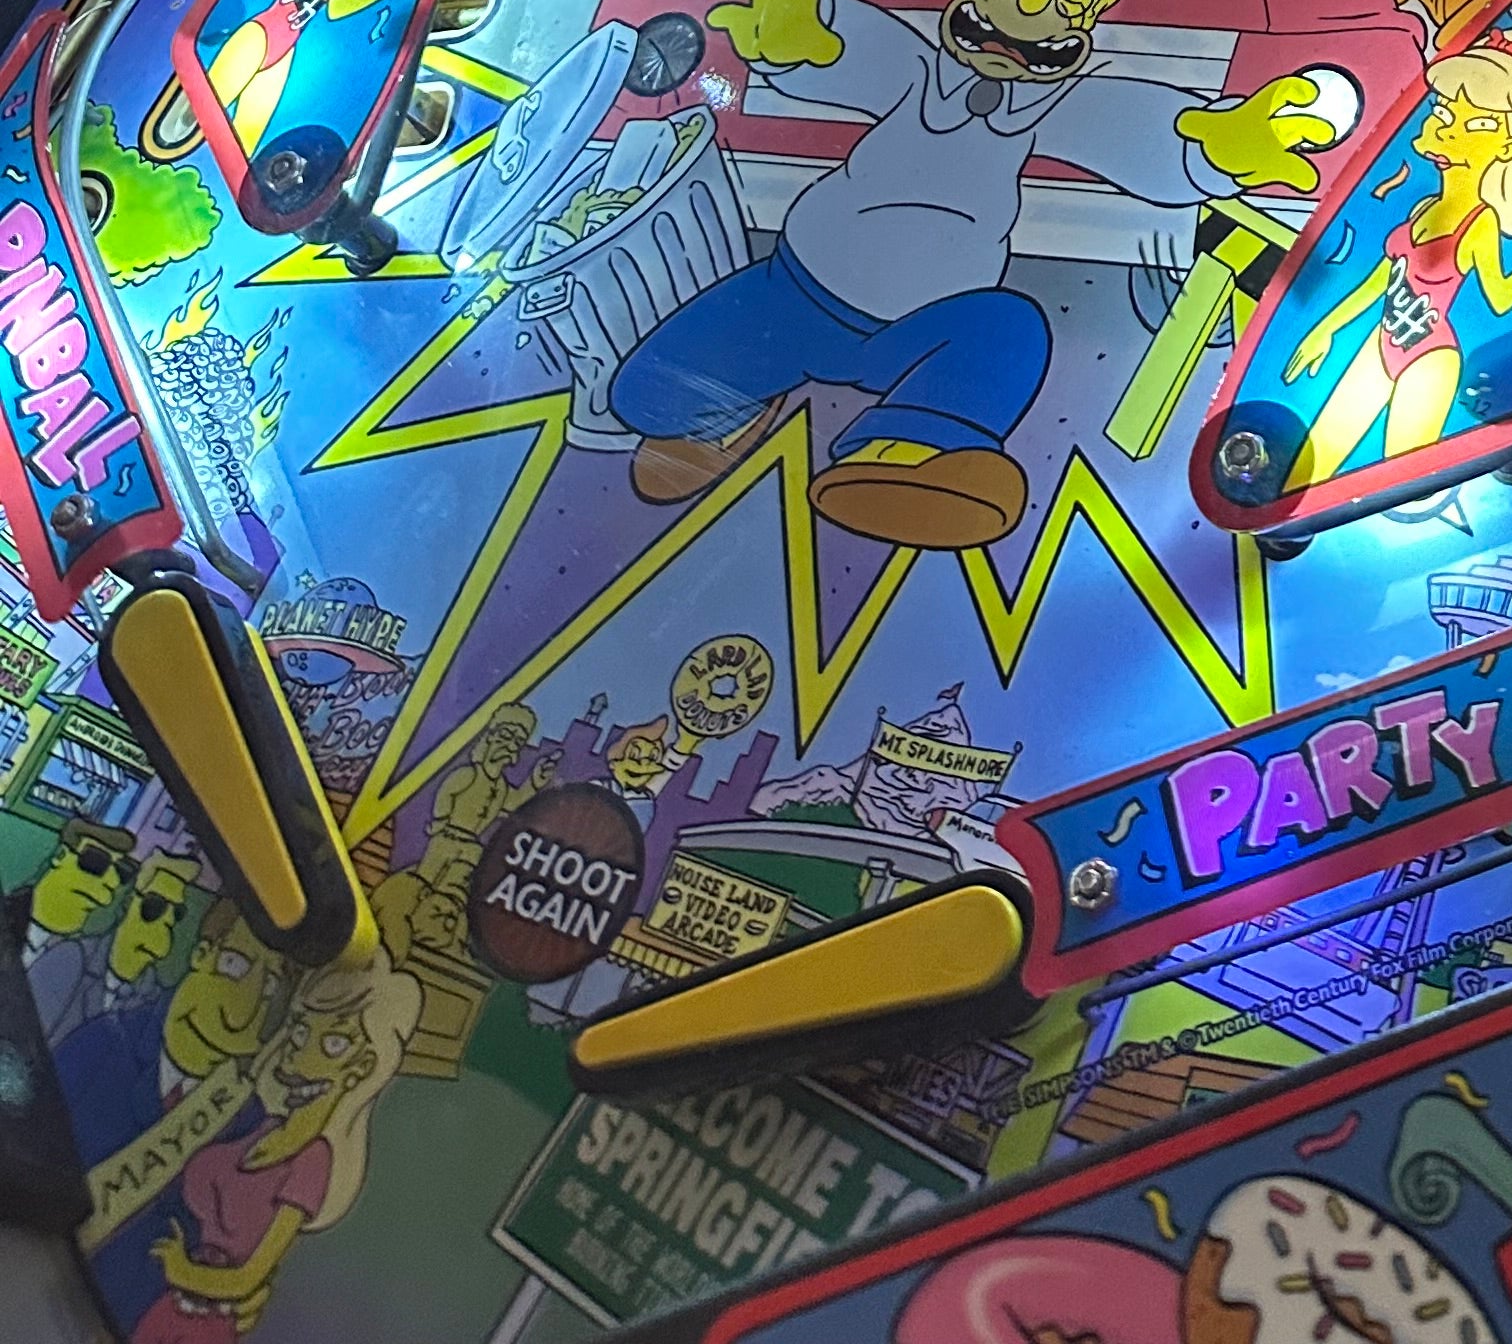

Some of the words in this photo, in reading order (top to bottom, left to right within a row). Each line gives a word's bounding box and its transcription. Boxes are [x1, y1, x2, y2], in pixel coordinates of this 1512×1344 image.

[261, 598, 348, 638] PLANET
[343, 603, 408, 654] HYPE
[688, 644, 747, 681] LARD
[877, 730, 907, 755] MT.
[907, 739, 1009, 778] SPLASHMORE
[1163, 689, 1503, 887] PARTY
[503, 831, 636, 905] SHOOT
[668, 862, 725, 899] NOISE
[725, 883, 778, 915] LAND
[486, 873, 613, 946] AGAIN
[660, 911, 741, 955] ARCADE
[685, 893, 742, 932] VIDEO
[1159, 1036, 1177, 1057] &
[1199, 999, 1293, 1047] Twentieth
[1293, 973, 1369, 1013] Century
[1371, 958, 1404, 981] Fox
[1406, 943, 1448, 969] Film
[99, 1085, 236, 1215] MAYOR
